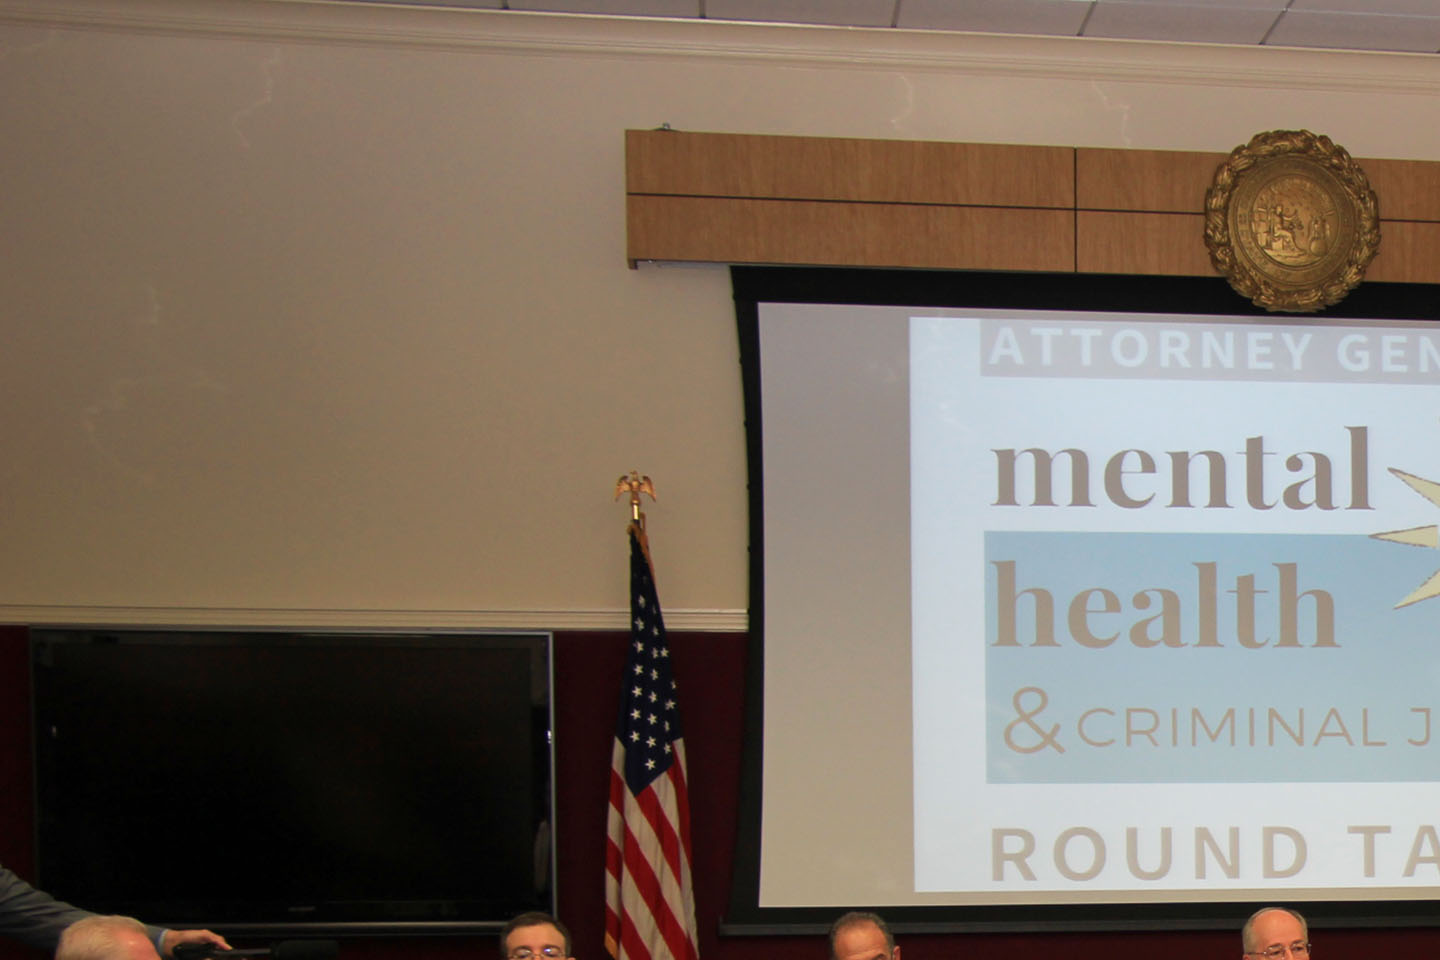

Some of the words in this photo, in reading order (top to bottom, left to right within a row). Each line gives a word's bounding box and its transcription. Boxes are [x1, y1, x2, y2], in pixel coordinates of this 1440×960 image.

[988, 327, 1315, 372] ATTORNEY
[989, 426, 1377, 511] mental
[990, 561, 1342, 650] health
[1004, 686, 1065, 755] &
[1077, 708, 1387, 748] CRIMINAL
[991, 826, 1309, 883] ROUND
